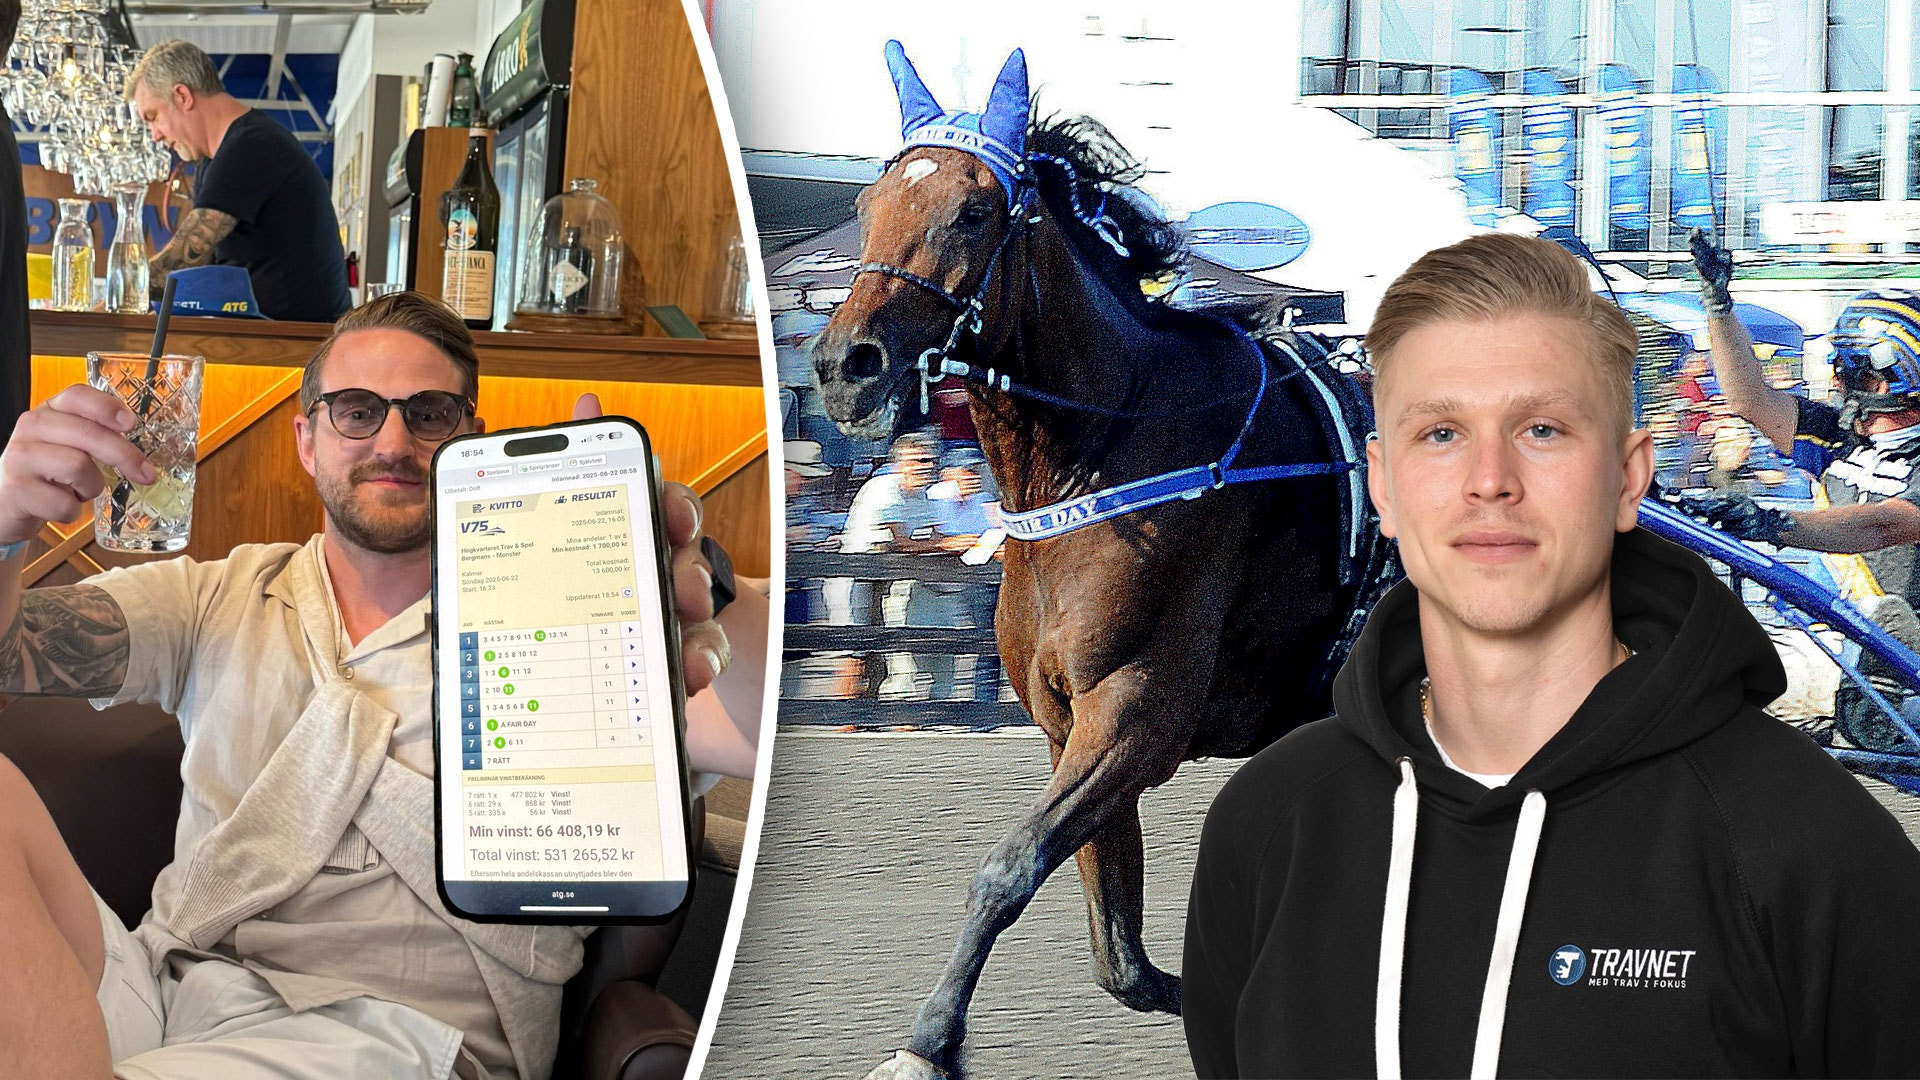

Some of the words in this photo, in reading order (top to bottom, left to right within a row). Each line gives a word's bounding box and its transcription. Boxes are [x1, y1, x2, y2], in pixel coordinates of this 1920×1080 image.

[221, 302, 248, 312] ATG
[461, 449, 484, 458] 18:54
[582, 470, 618, 479] 2025-06-22
[619, 467, 637, 475] 08:58
[571, 490, 617, 502] RESULTAT
[489, 500, 523, 511] KVITTO
[1050, 498, 1098, 527] DAY
[608, 515, 626, 523] 16:05
[461, 520, 489, 534] V75
[583, 535, 606, 543] andelar:
[520, 541, 534, 549] Spel
[564, 544, 592, 552] kostnad:
[598, 541, 620, 549] 700,00
[461, 554, 491, 562] Bergmans
[602, 557, 630, 566] kostnad:
[601, 566, 623, 574] 600,00
[485, 575, 519, 584] 2025-06-22
[566, 593, 600, 602] Uppdaterat
[602, 591, 619, 599] 18:54
[466, 637, 471, 645] 1
[466, 653, 473, 662] 2
[466, 670, 473, 678] 3
[467, 687, 473, 695] 4
[467, 704, 474, 713] 5
[468, 721, 474, 730] 6
[468, 739, 475, 748] 7
[550, 790, 571, 798] Vinst!
[551, 799, 571, 807] Vinst!
[552, 808, 572, 816] Vinst!
[469, 825, 493, 837] Min
[496, 825, 532, 837] vinst:
[536, 825, 553, 837] 66
[557, 824, 603, 839] 408,19
[607, 824, 621, 836] kr
[470, 848, 502, 861] Total
[505, 848, 540, 861] vinst:
[544, 848, 568, 861] 531
[572, 848, 618, 862] 265,52
[621, 847, 635, 860] kr
[470, 869, 500, 877] Eftersom
[501, 869, 516, 877] hela
[516, 869, 563, 877] andelskassan
[564, 870, 602, 879] utnyttjades
[618, 869, 633, 877] den
[551, 890, 575, 900] atg.se
[1591, 948, 1697, 978] TRAVNET
[1588, 978, 1609, 987] MED
[1613, 978, 1640, 988] TRAV
[1643, 979, 1650, 988] I
[1653, 979, 1687, 988] FOKUS
